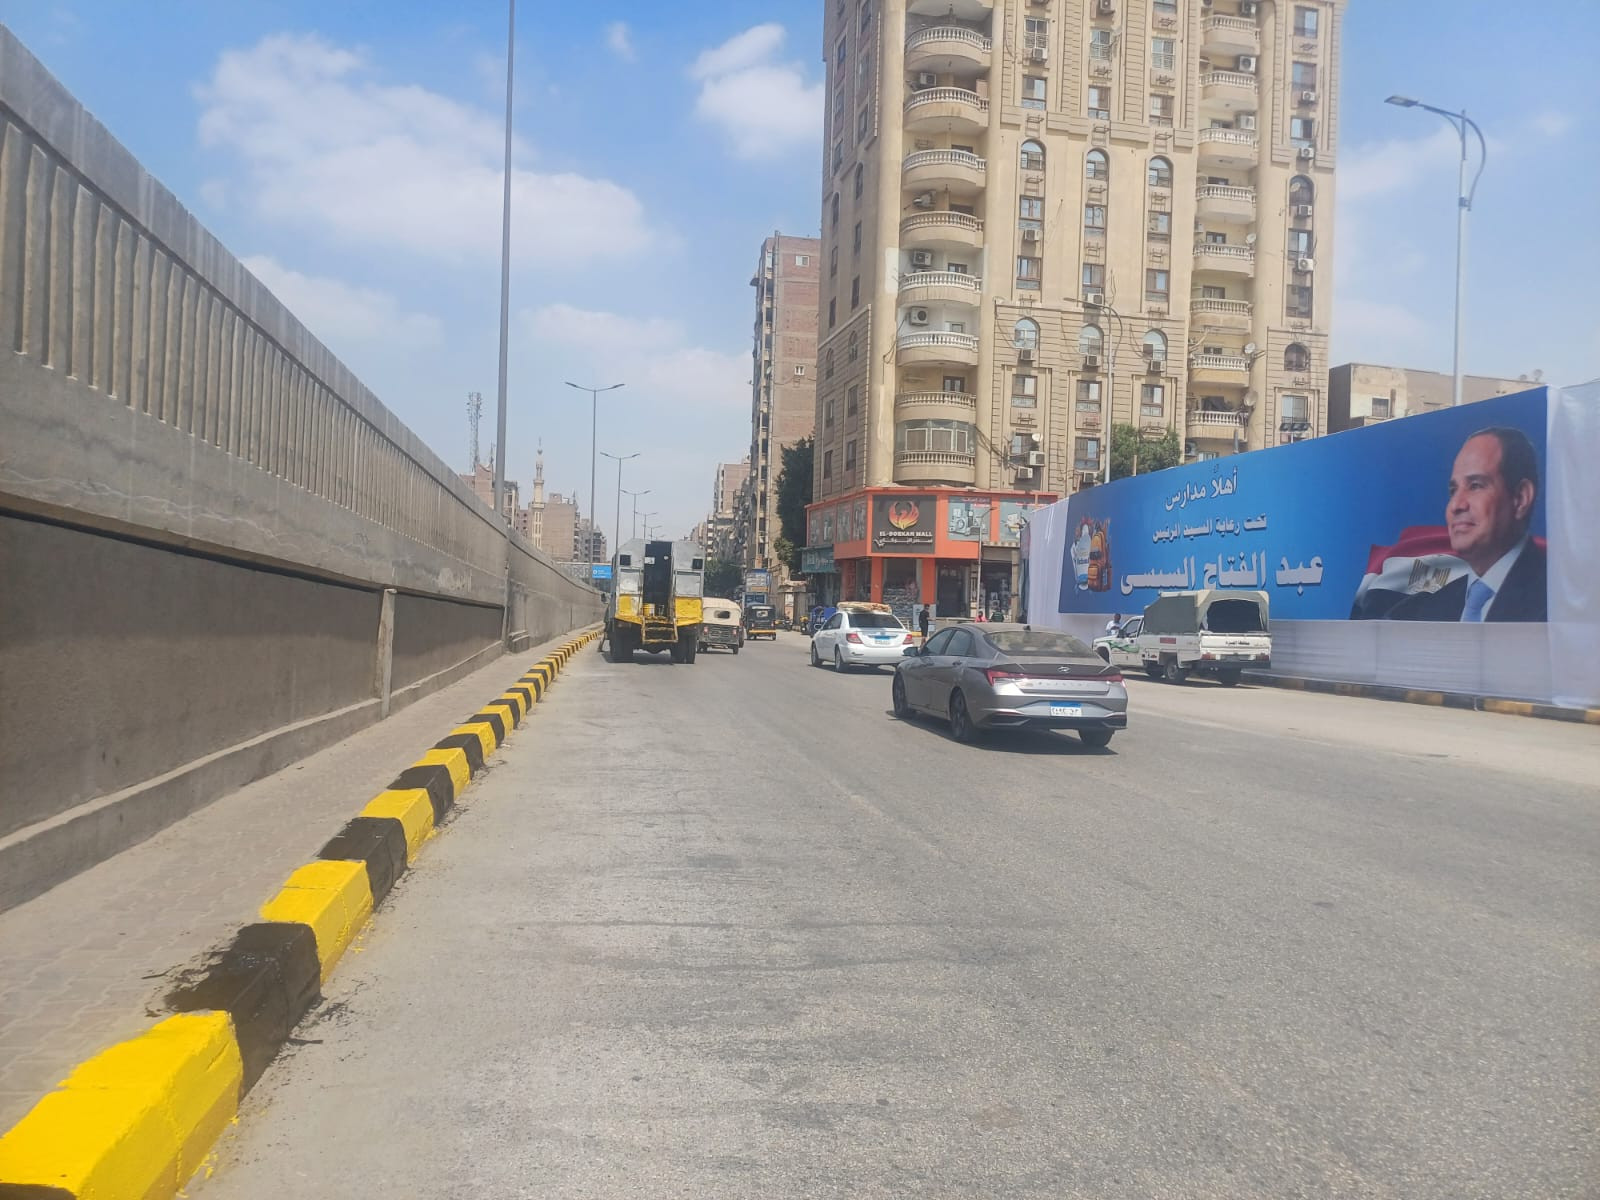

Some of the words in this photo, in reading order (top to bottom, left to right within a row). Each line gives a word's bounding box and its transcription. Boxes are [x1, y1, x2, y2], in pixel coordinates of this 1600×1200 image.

[1165, 482, 1206, 511] مدارس
[1152, 522, 1181, 544] الرئيس
[1183, 518, 1213, 542] السيد
[1215, 516, 1240, 538] رعاية
[1243, 512, 1268, 531] تحت
[1203, 550, 1267, 590] الفتاح
[1275, 555, 1324, 596] عبد
